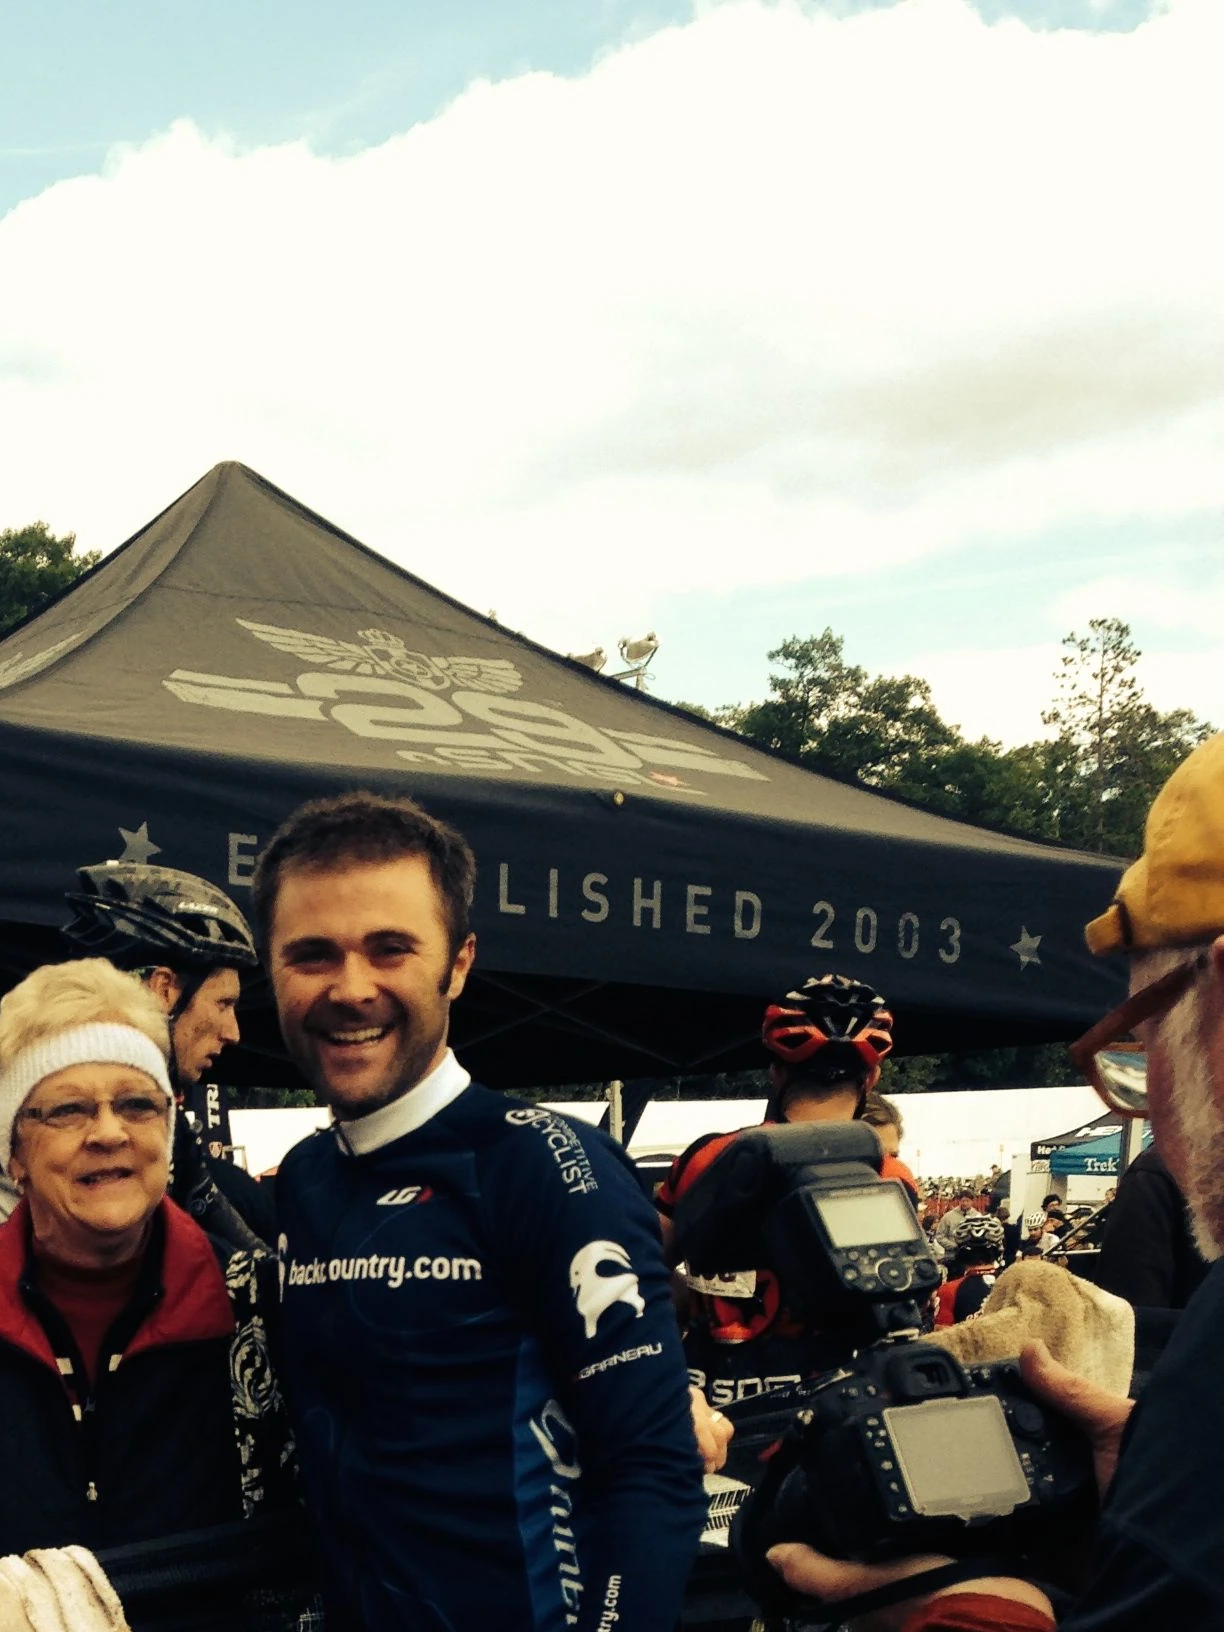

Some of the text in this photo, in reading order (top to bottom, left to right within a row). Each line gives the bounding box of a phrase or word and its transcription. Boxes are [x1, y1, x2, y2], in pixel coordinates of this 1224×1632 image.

[228, 832, 963, 965] ELISHED 2003
[531, 1117, 588, 1194] CYCLIST
[1084, 1157, 1120, 1173] Trek
[288, 1253, 483, 1289] backcountry.com
[578, 1341, 664, 1380] GARNEAU
